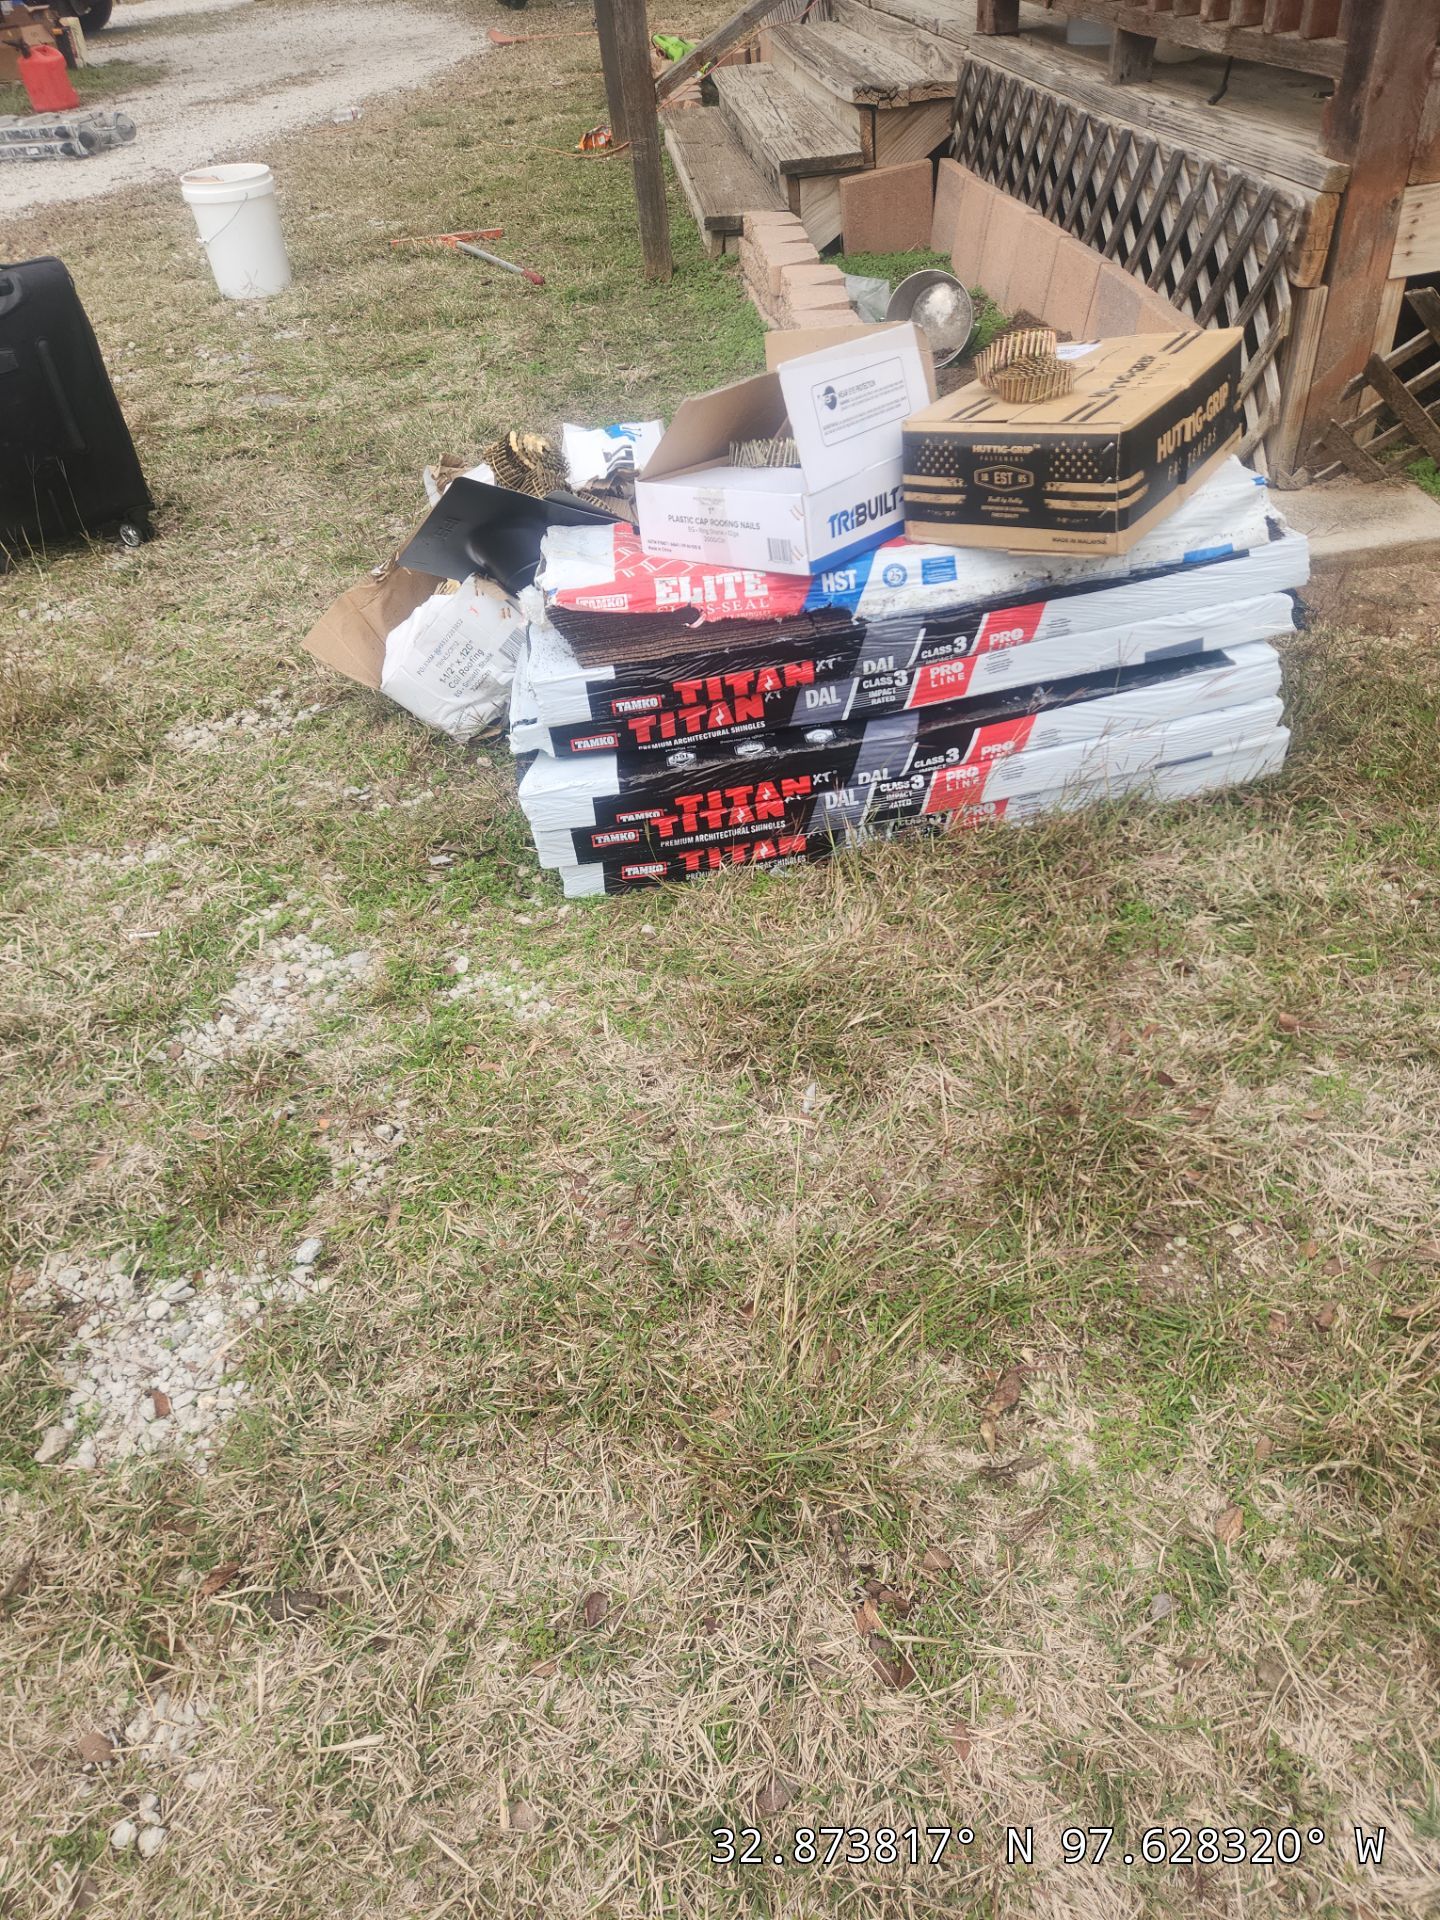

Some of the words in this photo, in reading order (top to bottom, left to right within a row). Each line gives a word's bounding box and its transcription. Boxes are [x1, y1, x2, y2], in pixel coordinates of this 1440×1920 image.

[1168, 427, 1217, 482] FATENERS
[993, 472, 1013, 485] EST
[668, 515, 694, 524] PLASTIC
[695, 517, 709, 526] CAP
[740, 522, 760, 530] NAILS
[654, 571, 769, 605] ELITE
[821, 569, 857, 593] HST
[581, 597, 627, 609] TAMKO
[989, 628, 1024, 646] PRO
[921, 645, 952, 659] CLASS
[953, 636, 967, 654] 3
[448, 675, 461, 689] Coil
[458, 648, 485, 677] Roofing
[863, 656, 898, 676] DAL
[930, 661, 965, 679] PRO
[615, 697, 659, 713] TAMKO
[673, 660, 815, 705] TITAN
[815, 657, 836, 674] XT
[863, 676, 894, 689] CLASS
[894, 670, 909, 687] 3
[930, 672, 965, 688] LINE
[805, 686, 841, 708] DAL
[868, 687, 897, 698] IMPACT
[871, 695, 896, 705] RATED
[574, 735, 615, 750] TAMKO
[627, 694, 765, 743] TITAN
[639, 738, 672, 750] PREMIUM
[673, 729, 729, 746] ARCHITECTURAL
[731, 721, 766, 735] SHINGLES
[981, 740, 1015, 756] PRO
[914, 755, 945, 769] CLASS
[945, 748, 960, 763] 3
[858, 768, 891, 785] DAL
[880, 781, 910, 793] CLASS
[910, 774, 924, 790] 3
[945, 766, 979, 782] PRO
[946, 776, 980, 792] LINE
[619, 810, 661, 822] TAMKO
[675, 775, 811, 814] TITAN
[812, 771, 831, 786] XT
[825, 789, 860, 810] DAL
[886, 791, 913, 800] IMPACT
[888, 799, 913, 809] RATED
[595, 831, 636, 845] TAMKO
[651, 800, 785, 838] TITAN
[660, 834, 694, 848] PREMIUM
[695, 827, 750, 842] ARCHITECTURAL
[750, 820, 786, 834] SHINGLES
[624, 866, 665, 876] TAMKO
[678, 835, 807, 871] TITAN
